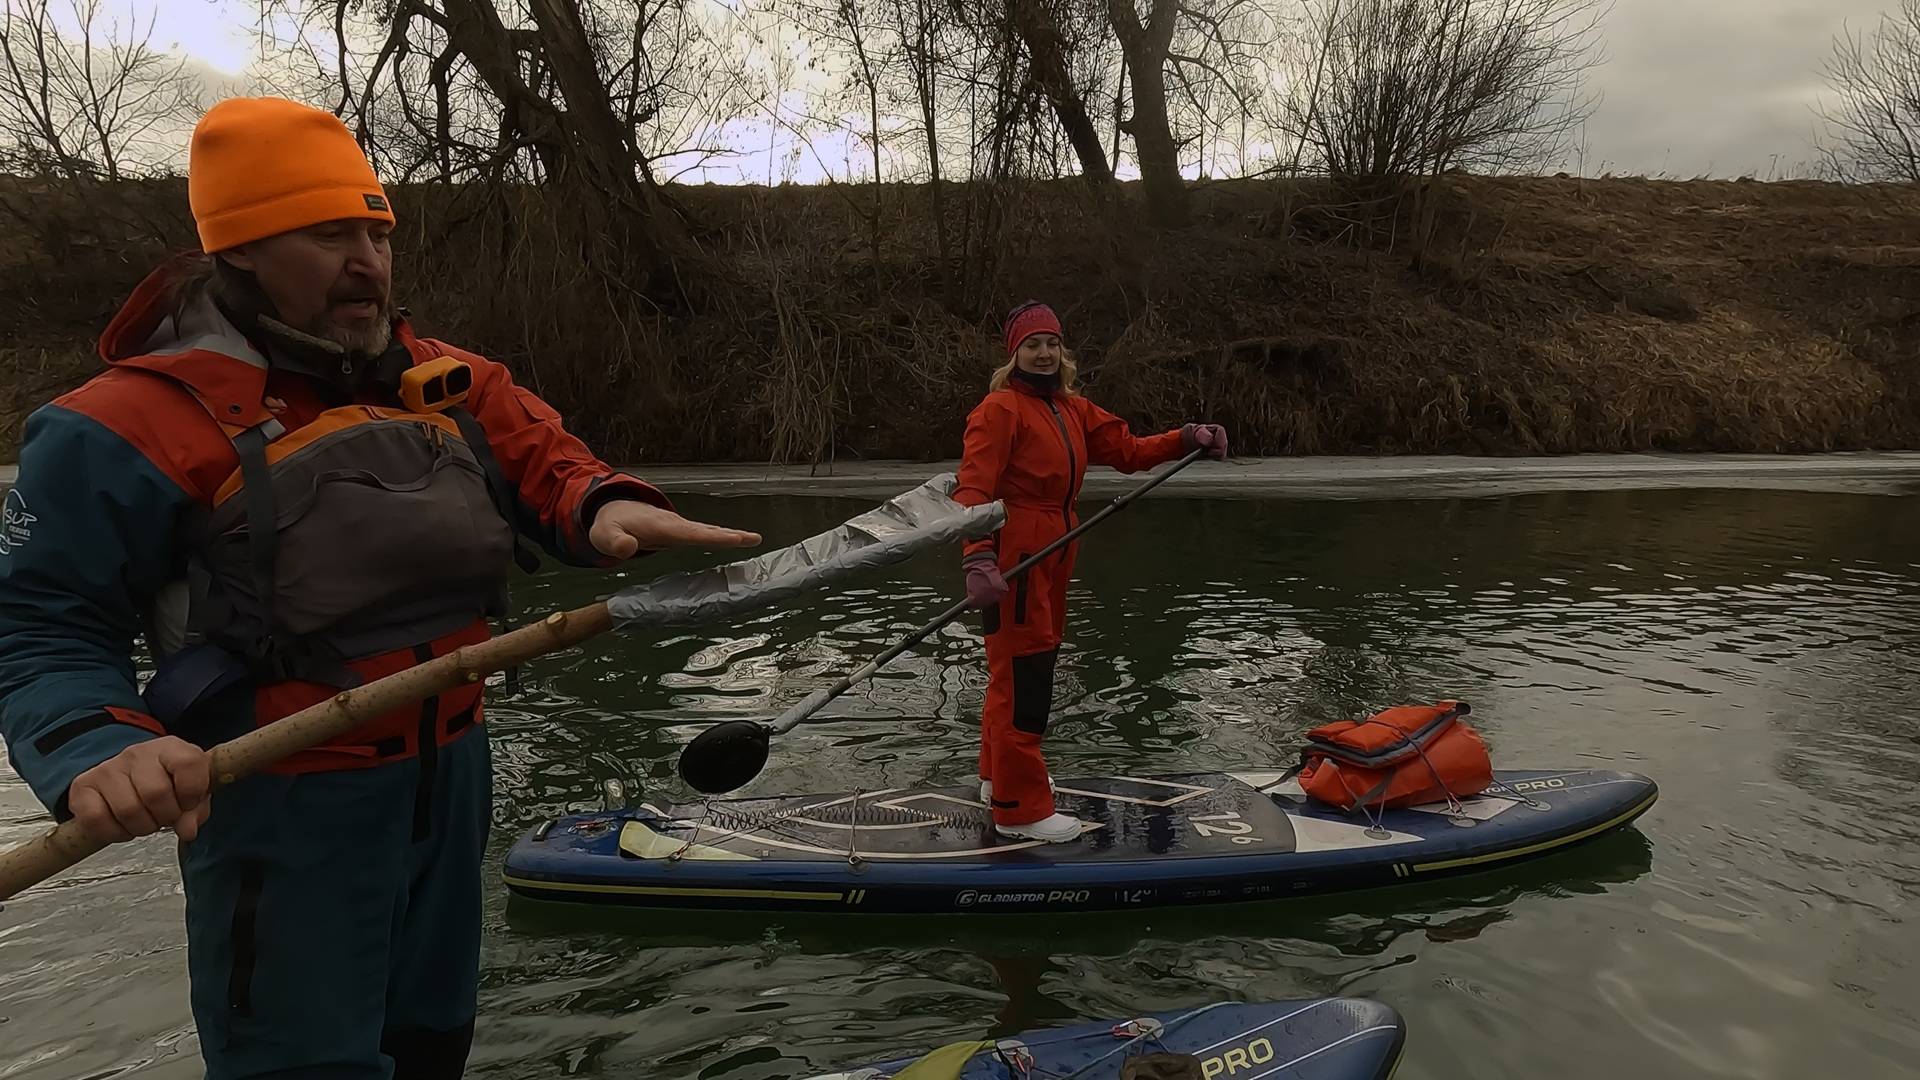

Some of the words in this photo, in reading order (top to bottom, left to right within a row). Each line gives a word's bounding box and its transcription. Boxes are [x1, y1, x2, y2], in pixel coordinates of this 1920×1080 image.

[1514, 778, 1564, 791] PRO
[1047, 890, 1090, 903] PRO
[1201, 1037, 1275, 1080] PRO
